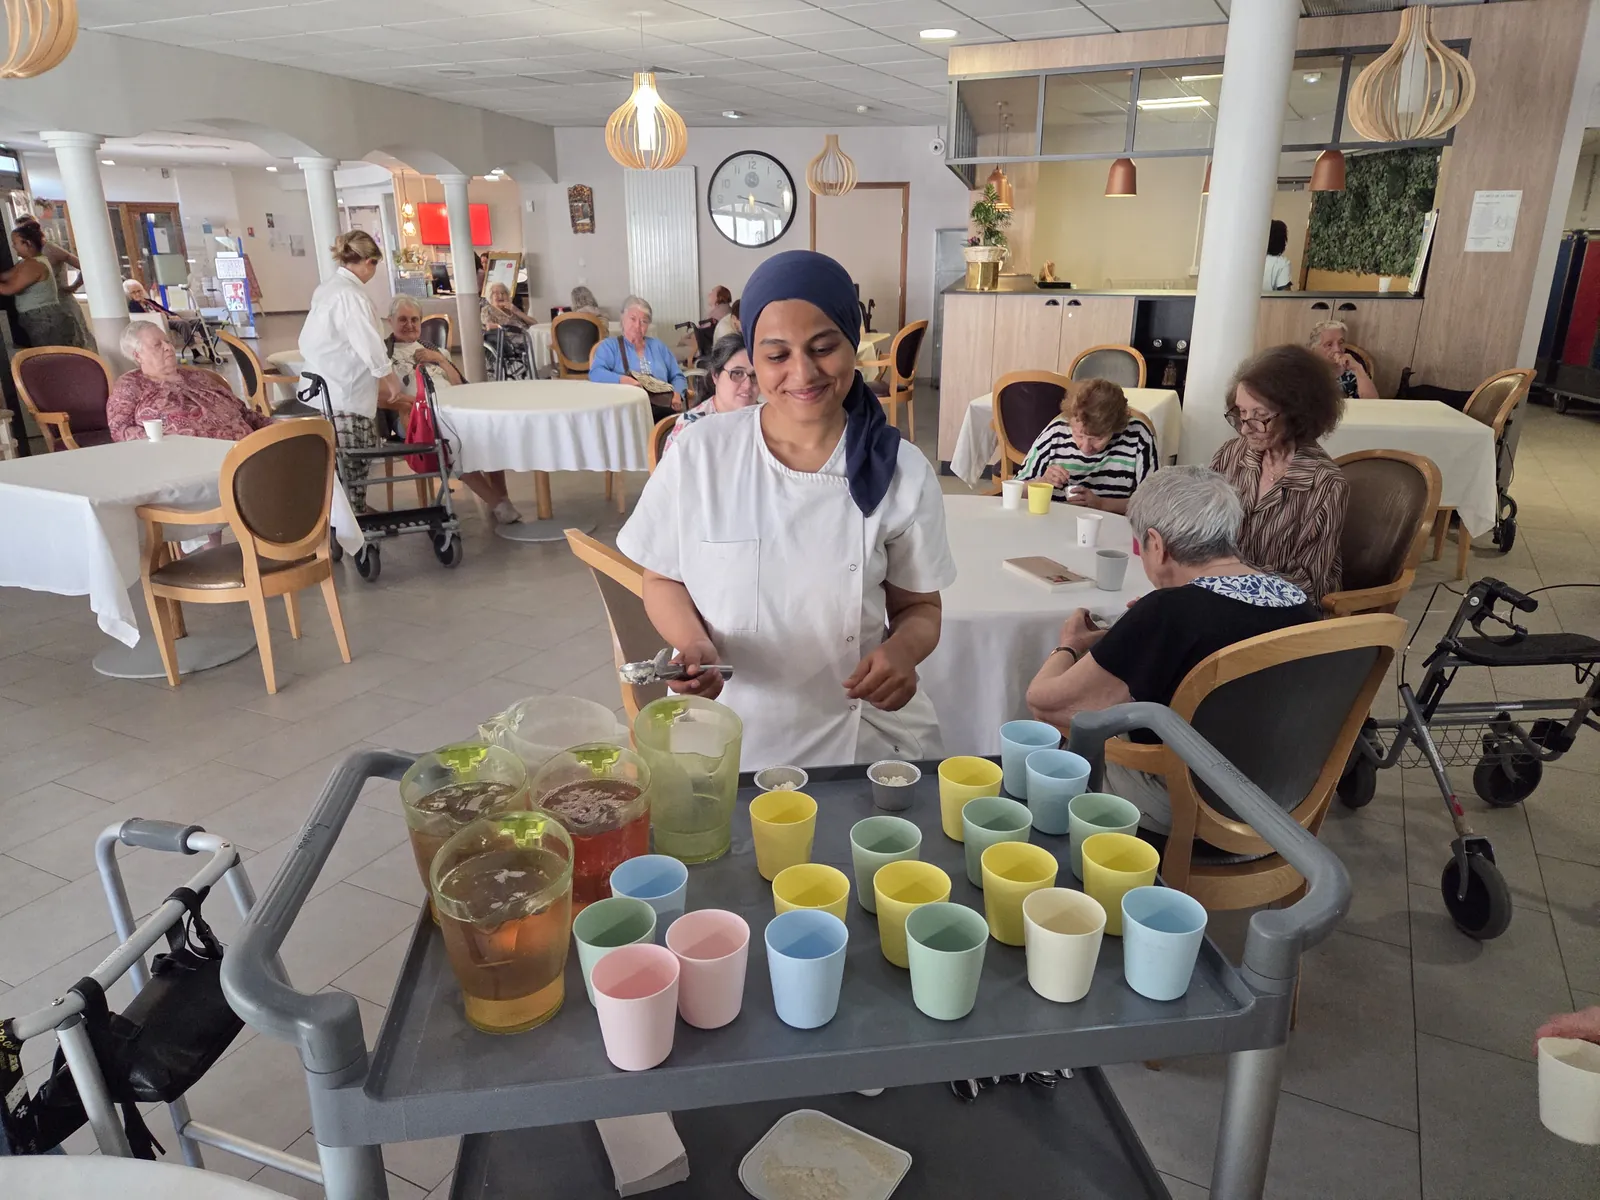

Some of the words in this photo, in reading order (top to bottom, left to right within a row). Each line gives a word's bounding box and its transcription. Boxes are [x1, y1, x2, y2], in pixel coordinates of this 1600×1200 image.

[748, 161, 757, 170] 12
[734, 166, 740, 175] 11
[722, 179, 730, 189] 10
[777, 180, 783, 189] 2
